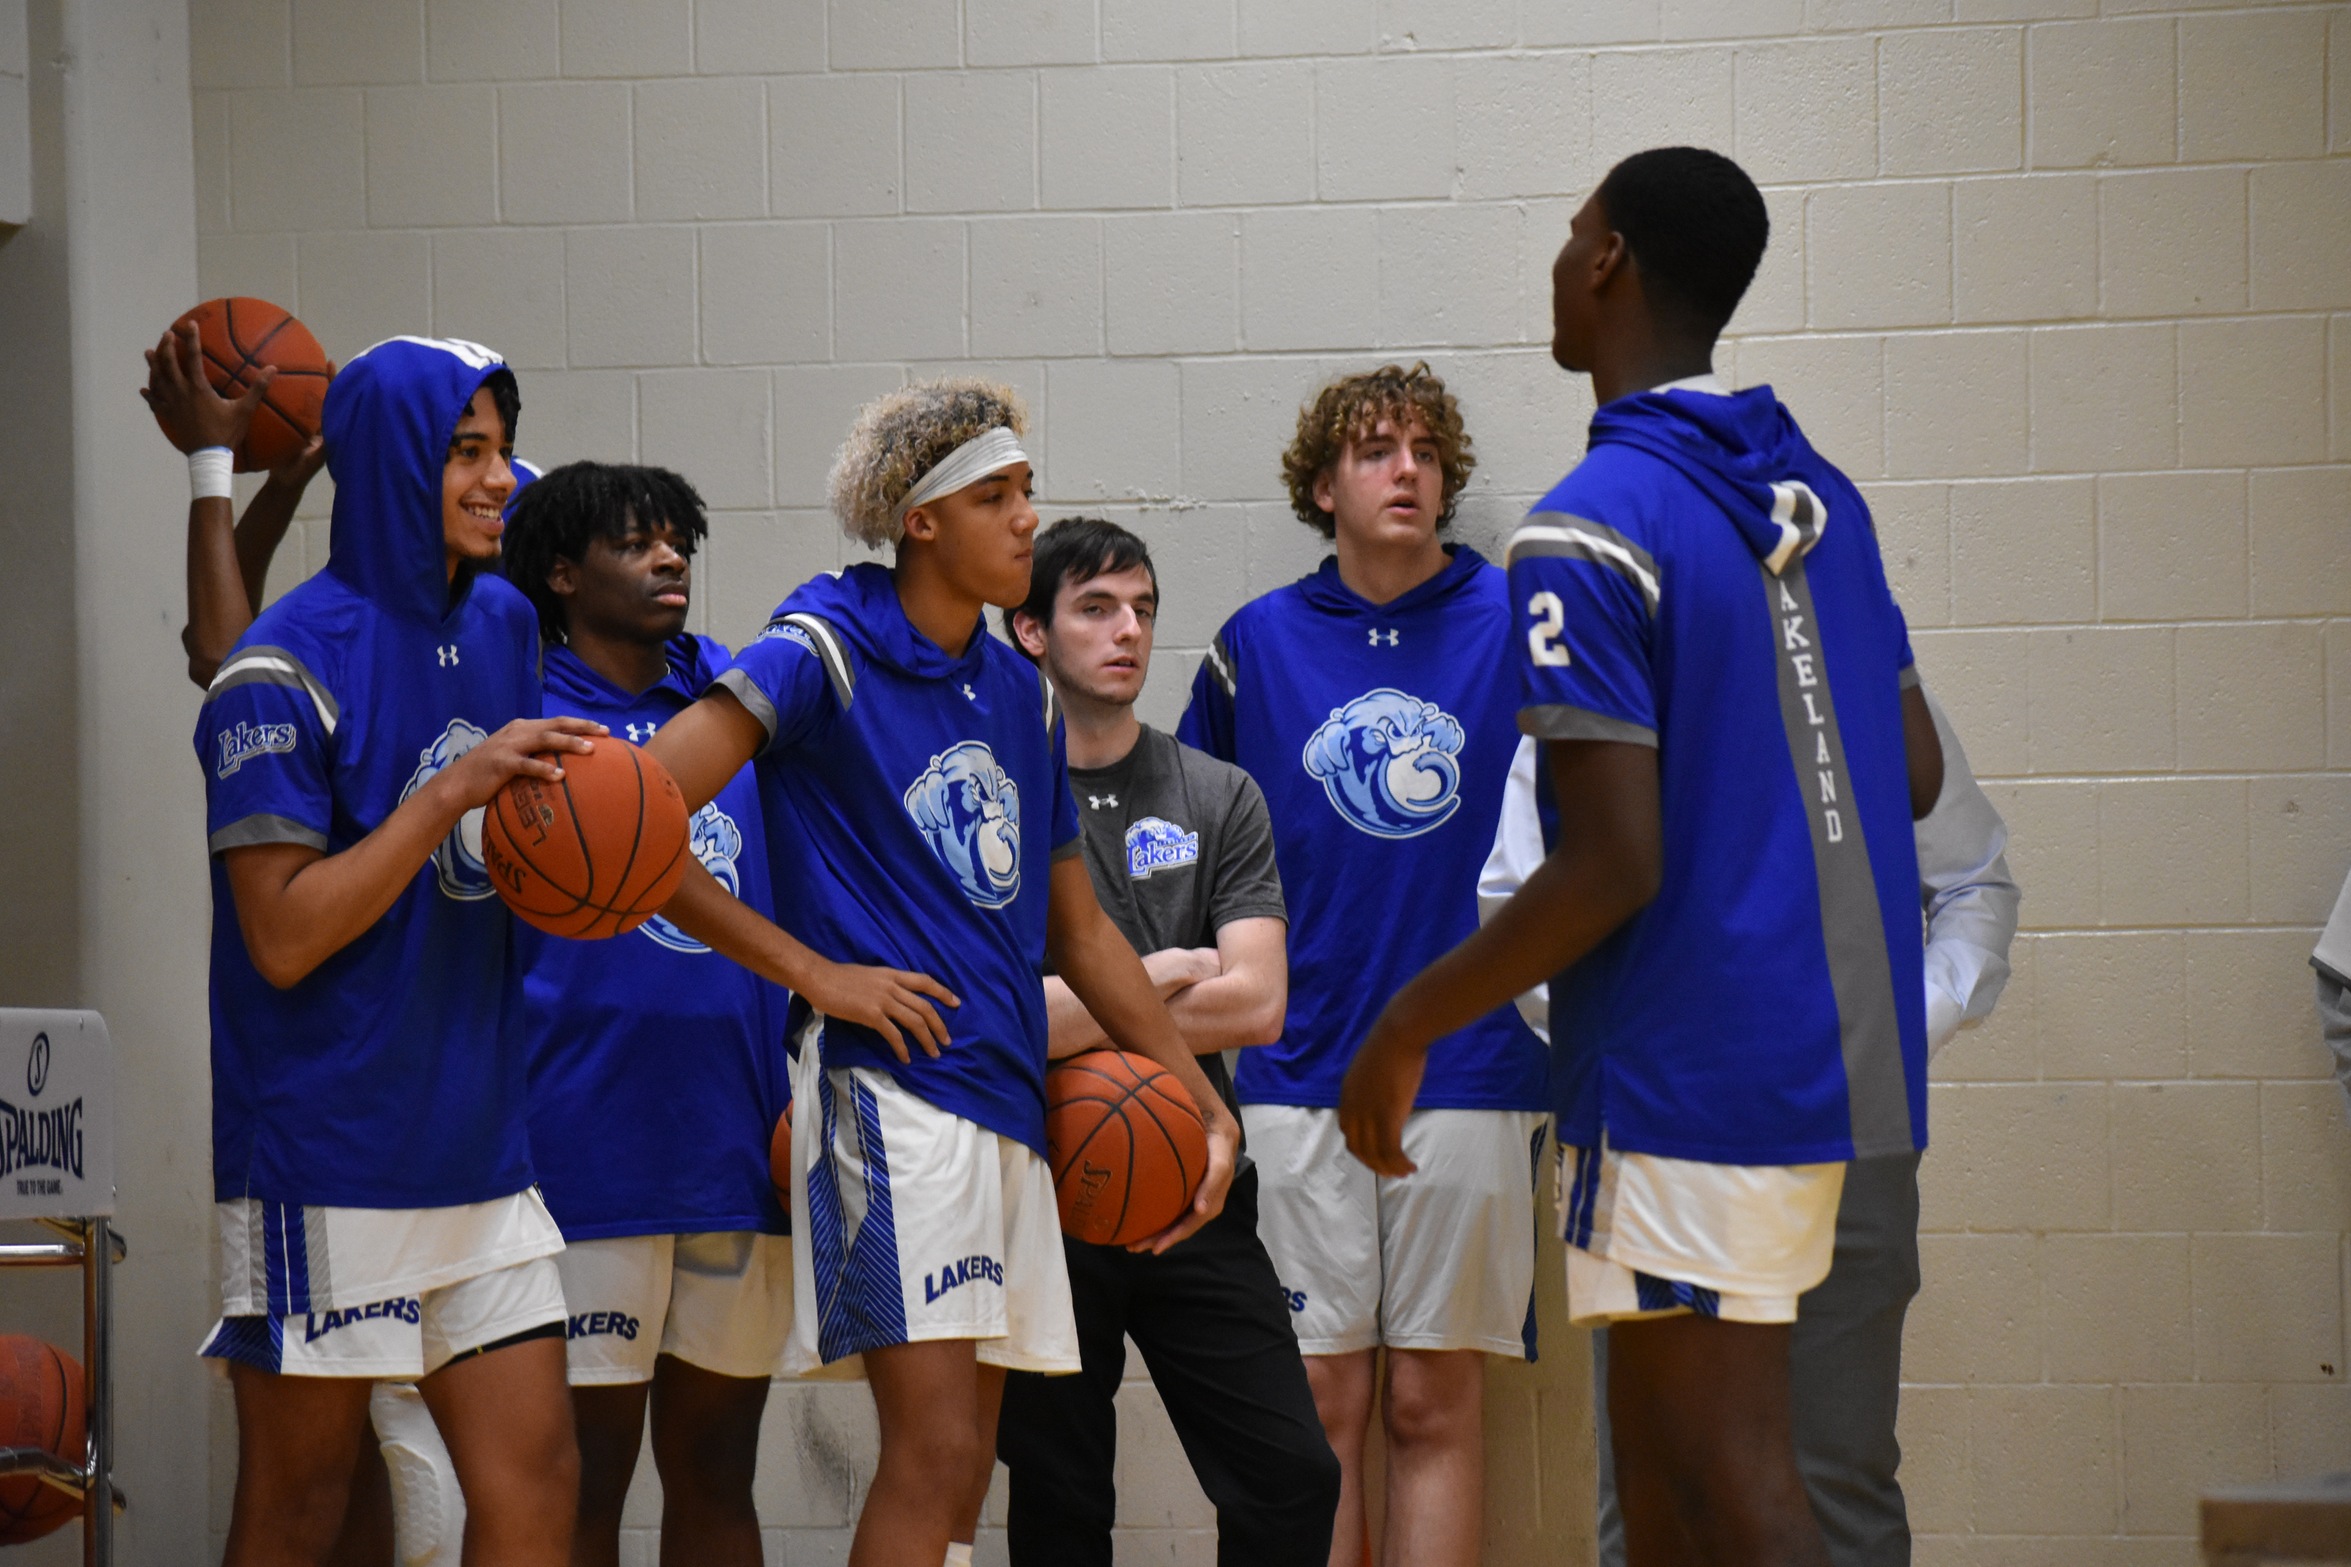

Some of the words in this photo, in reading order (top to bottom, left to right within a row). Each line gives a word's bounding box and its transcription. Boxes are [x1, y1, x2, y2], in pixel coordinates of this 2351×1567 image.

[1528, 591, 1571, 667] 2
[1779, 579, 1843, 842] AKELAND
[218, 721, 297, 780] Lakers
[1127, 840, 1199, 880] Lakers
[925, 1254, 1004, 1306] LAKERS
[305, 1296, 420, 1343] LAKERS
[568, 1311, 640, 1341] KERS
